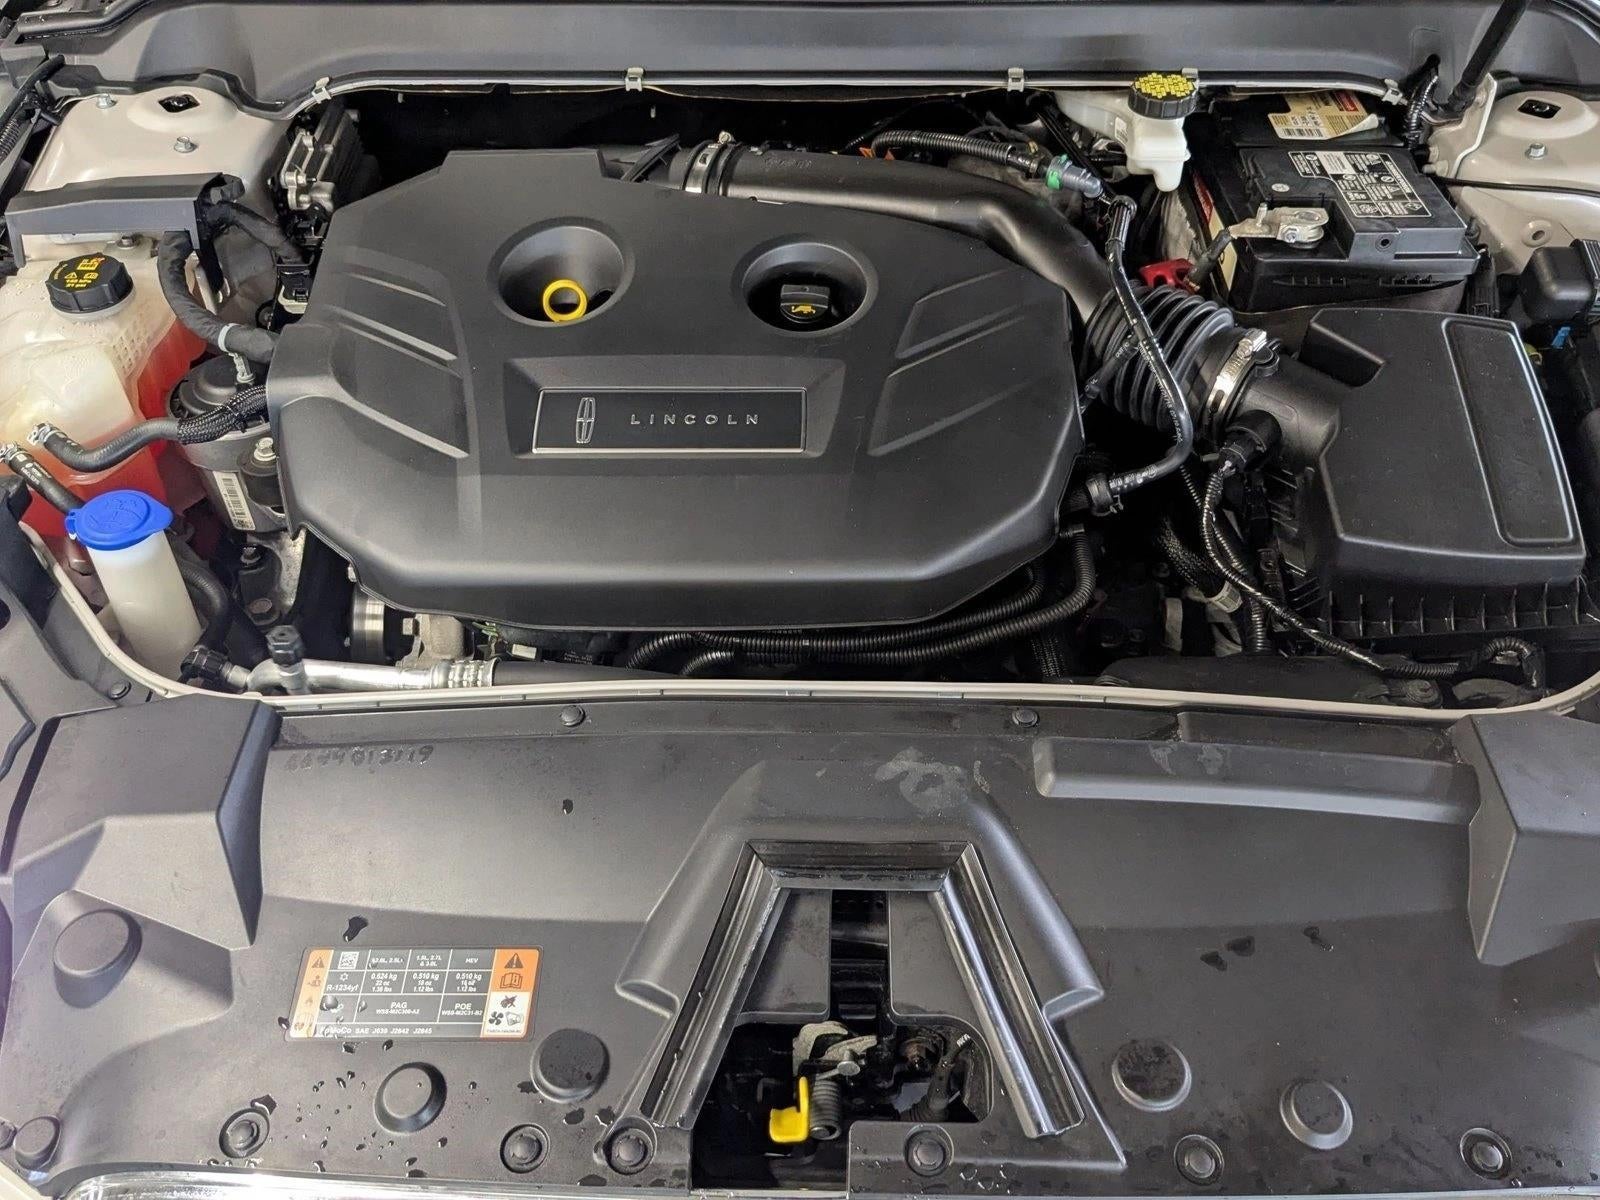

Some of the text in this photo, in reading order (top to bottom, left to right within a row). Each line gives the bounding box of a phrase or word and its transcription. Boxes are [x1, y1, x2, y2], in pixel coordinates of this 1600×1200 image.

[630, 414, 759, 425] LINCOLN
[388, 973, 398, 981] kg
[431, 973, 440, 981] kg
[473, 973, 482, 981] kg
[326, 984, 359, 992] R-1234yf
[390, 1001, 408, 1009] PAG
